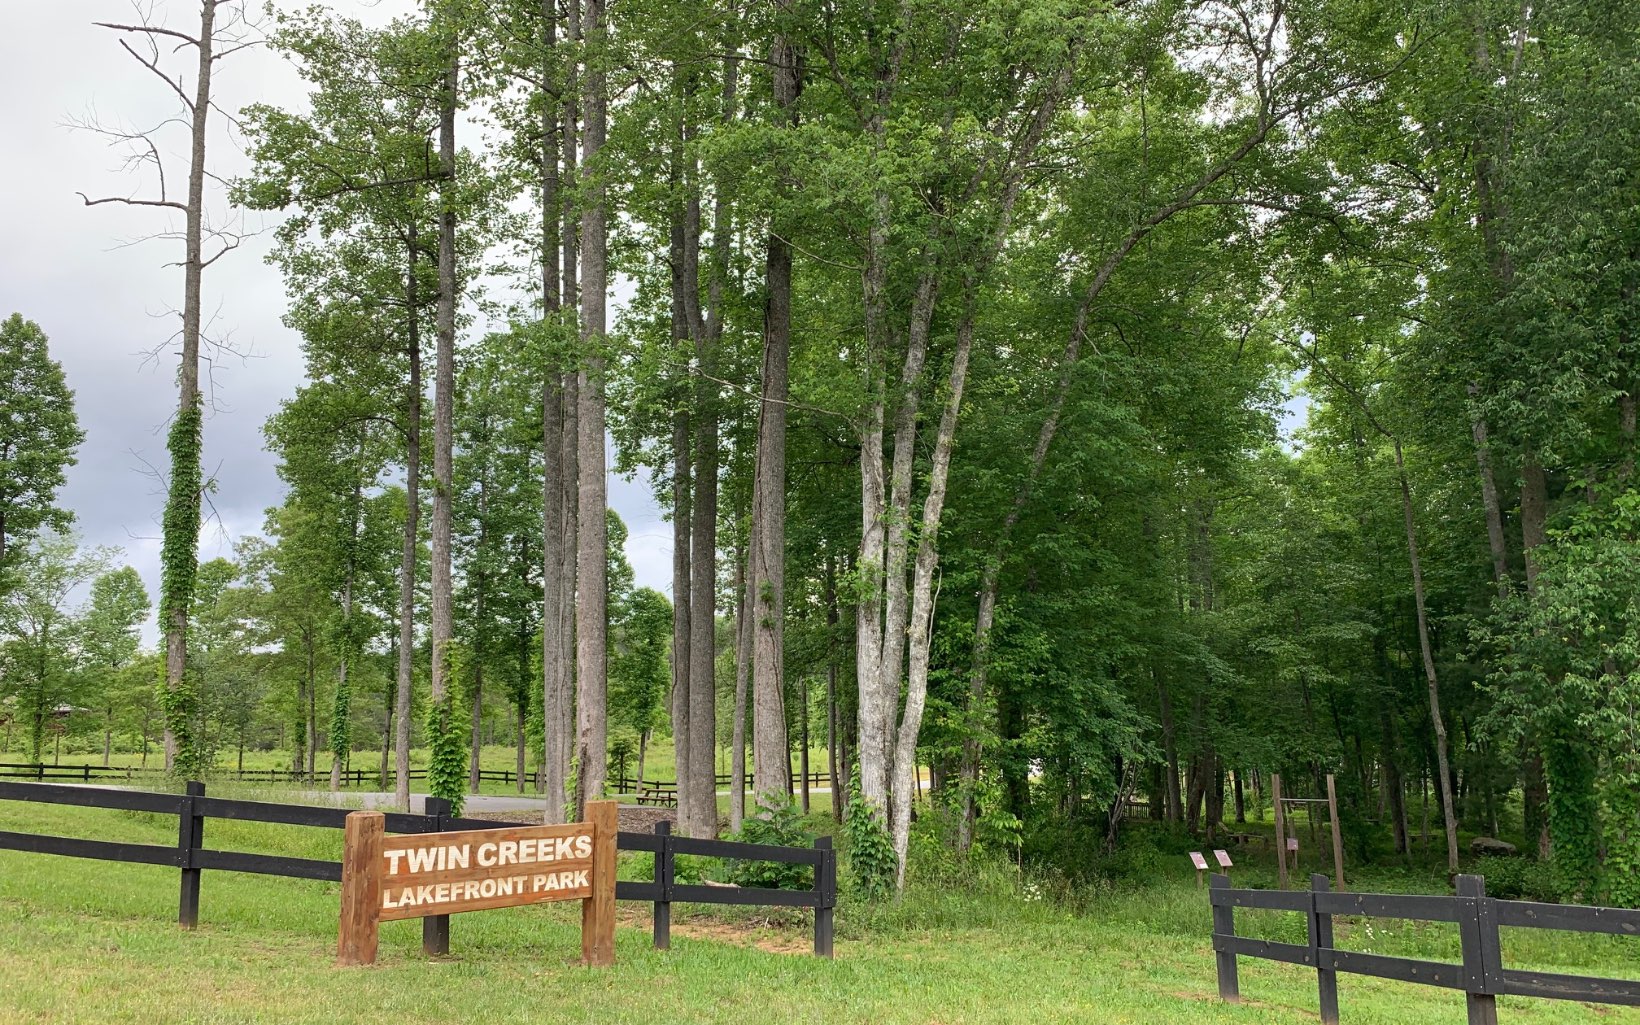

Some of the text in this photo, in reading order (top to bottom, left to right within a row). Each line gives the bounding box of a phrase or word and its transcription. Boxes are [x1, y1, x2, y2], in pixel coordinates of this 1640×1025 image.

[384, 835, 592, 875] TWIN CREEKS
[383, 870, 589, 909] LAKEFRONT PARK
